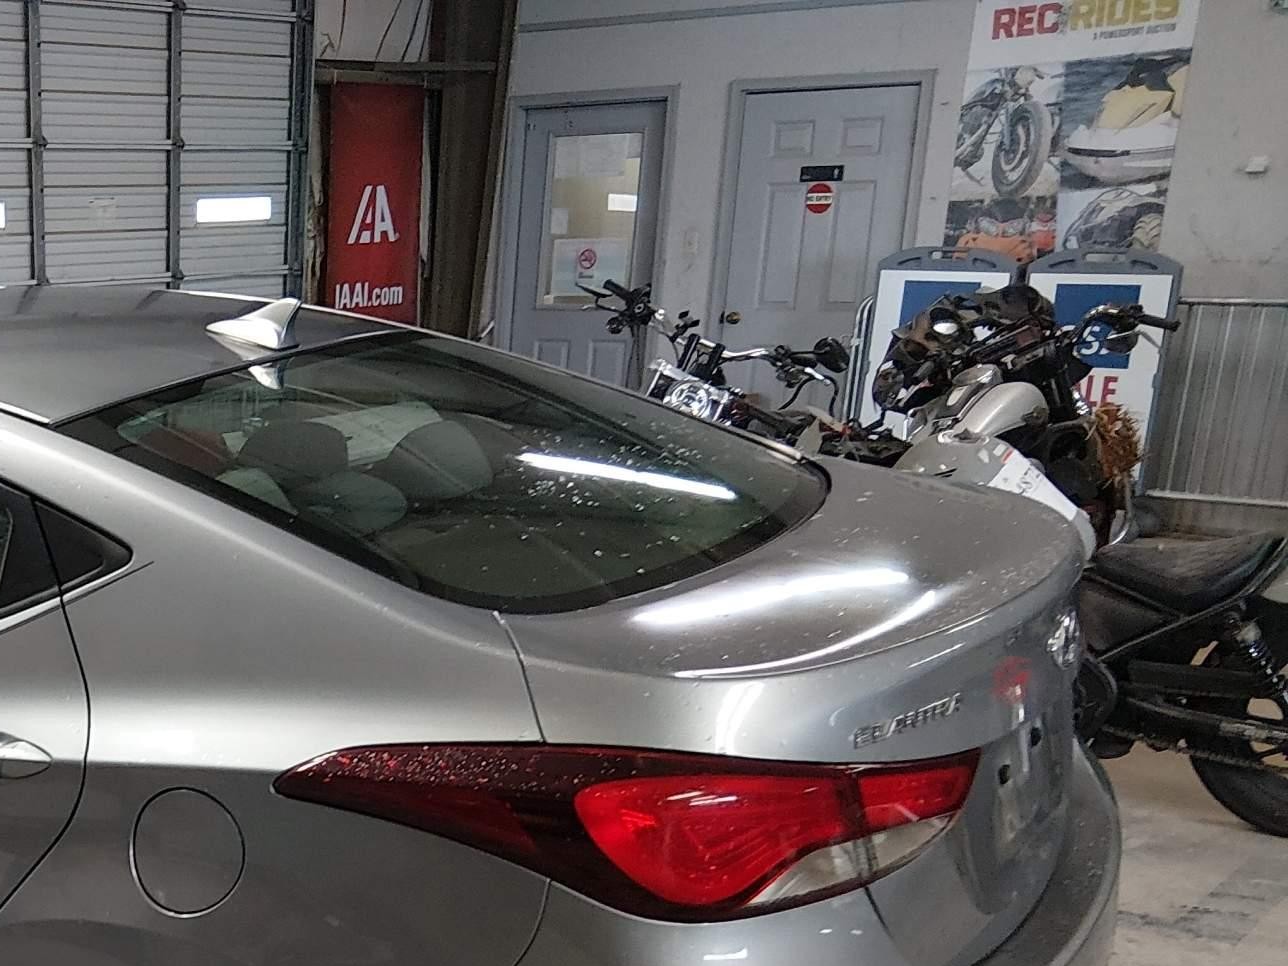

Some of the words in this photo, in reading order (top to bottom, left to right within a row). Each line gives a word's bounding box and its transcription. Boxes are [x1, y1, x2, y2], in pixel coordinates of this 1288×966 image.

[992, 2, 1064, 40] REC
[1070, 0, 1182, 31] RIDES
[335, 281, 403, 310] IAAI.com
